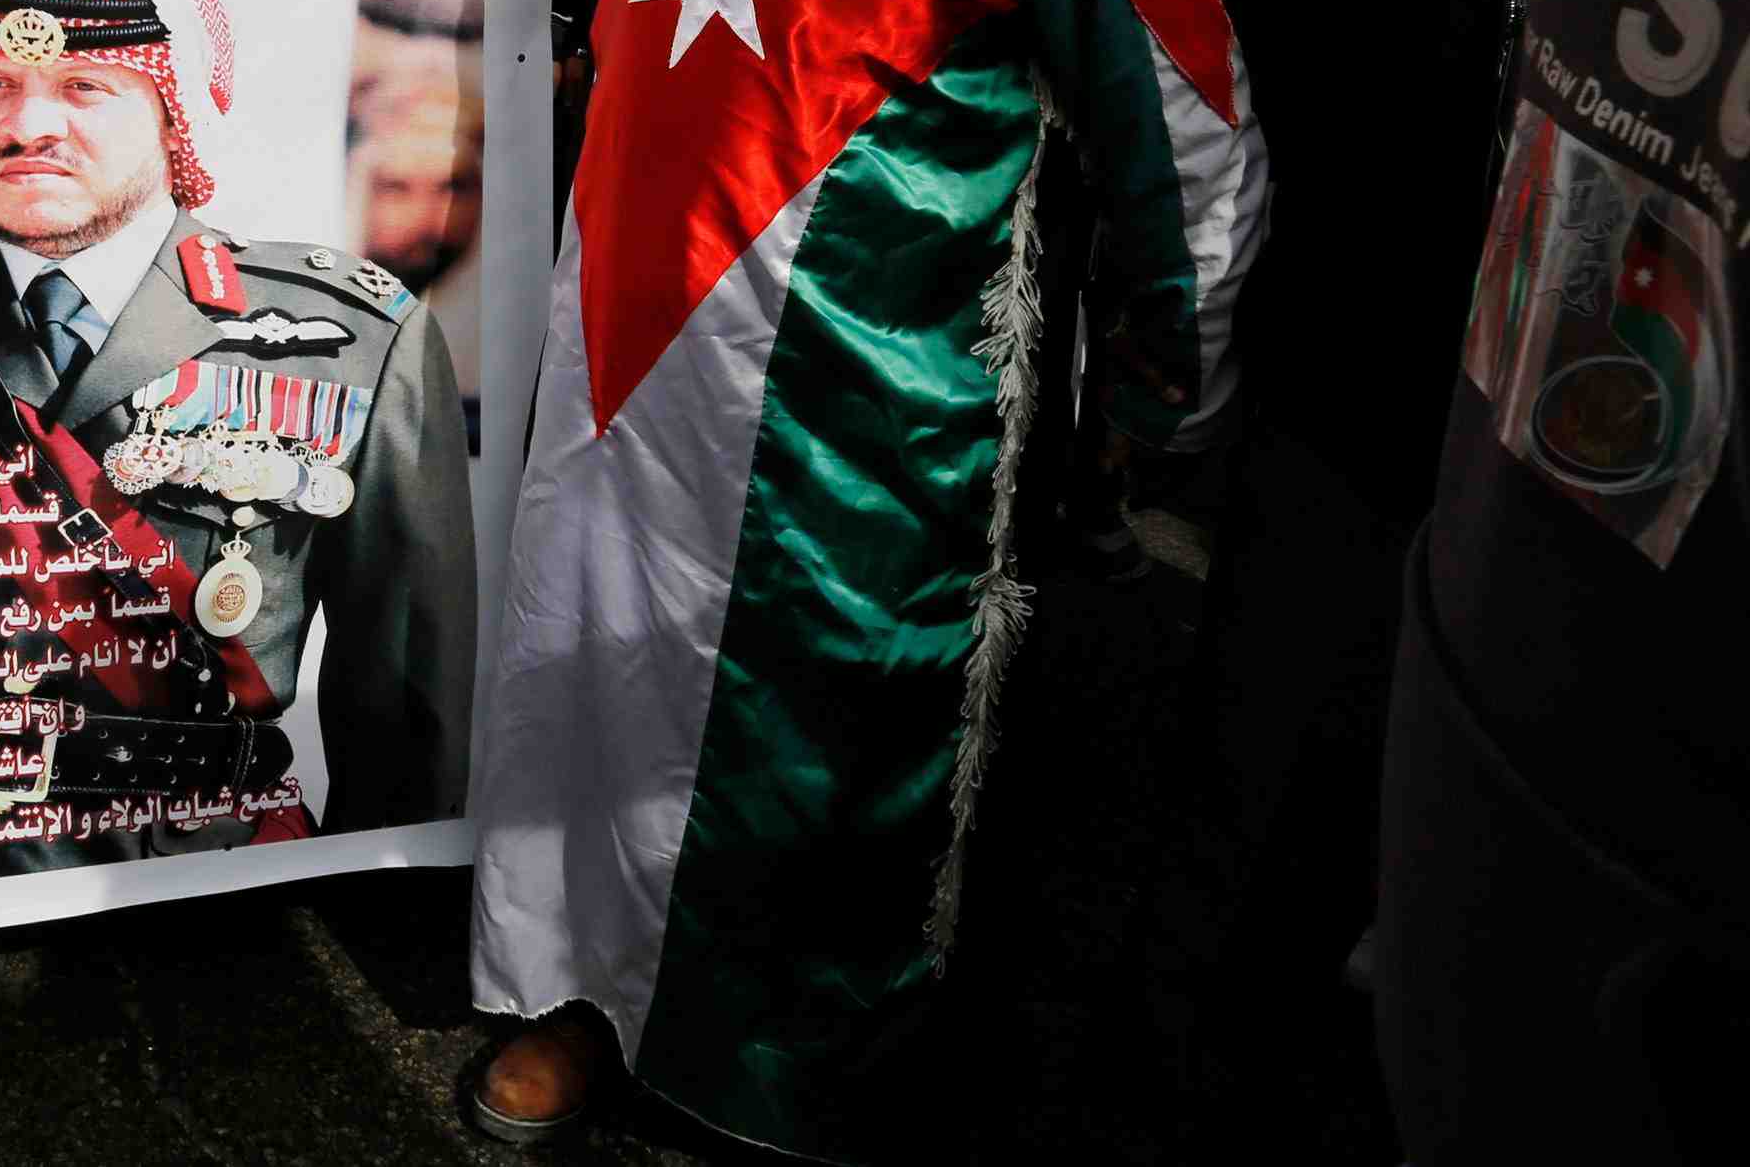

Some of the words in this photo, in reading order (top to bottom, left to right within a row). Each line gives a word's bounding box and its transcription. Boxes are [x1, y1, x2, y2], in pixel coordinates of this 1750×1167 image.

[1536, 37, 1576, 100] Raw
[1576, 78, 1675, 167] Denim
[34, 542, 133, 581] سأخلص
[139, 540, 176, 577] إني
[0, 598, 40, 637] رفع
[47, 601, 96, 633] بمن
[22, 647, 72, 683] على
[78, 634, 122, 679] أنام
[128, 634, 146, 665] لا
[152, 632, 178, 670] أن
[98, 794, 162, 832] الولاء
[166, 785, 235, 831] شباب
[238, 776, 304, 825] تجمع
